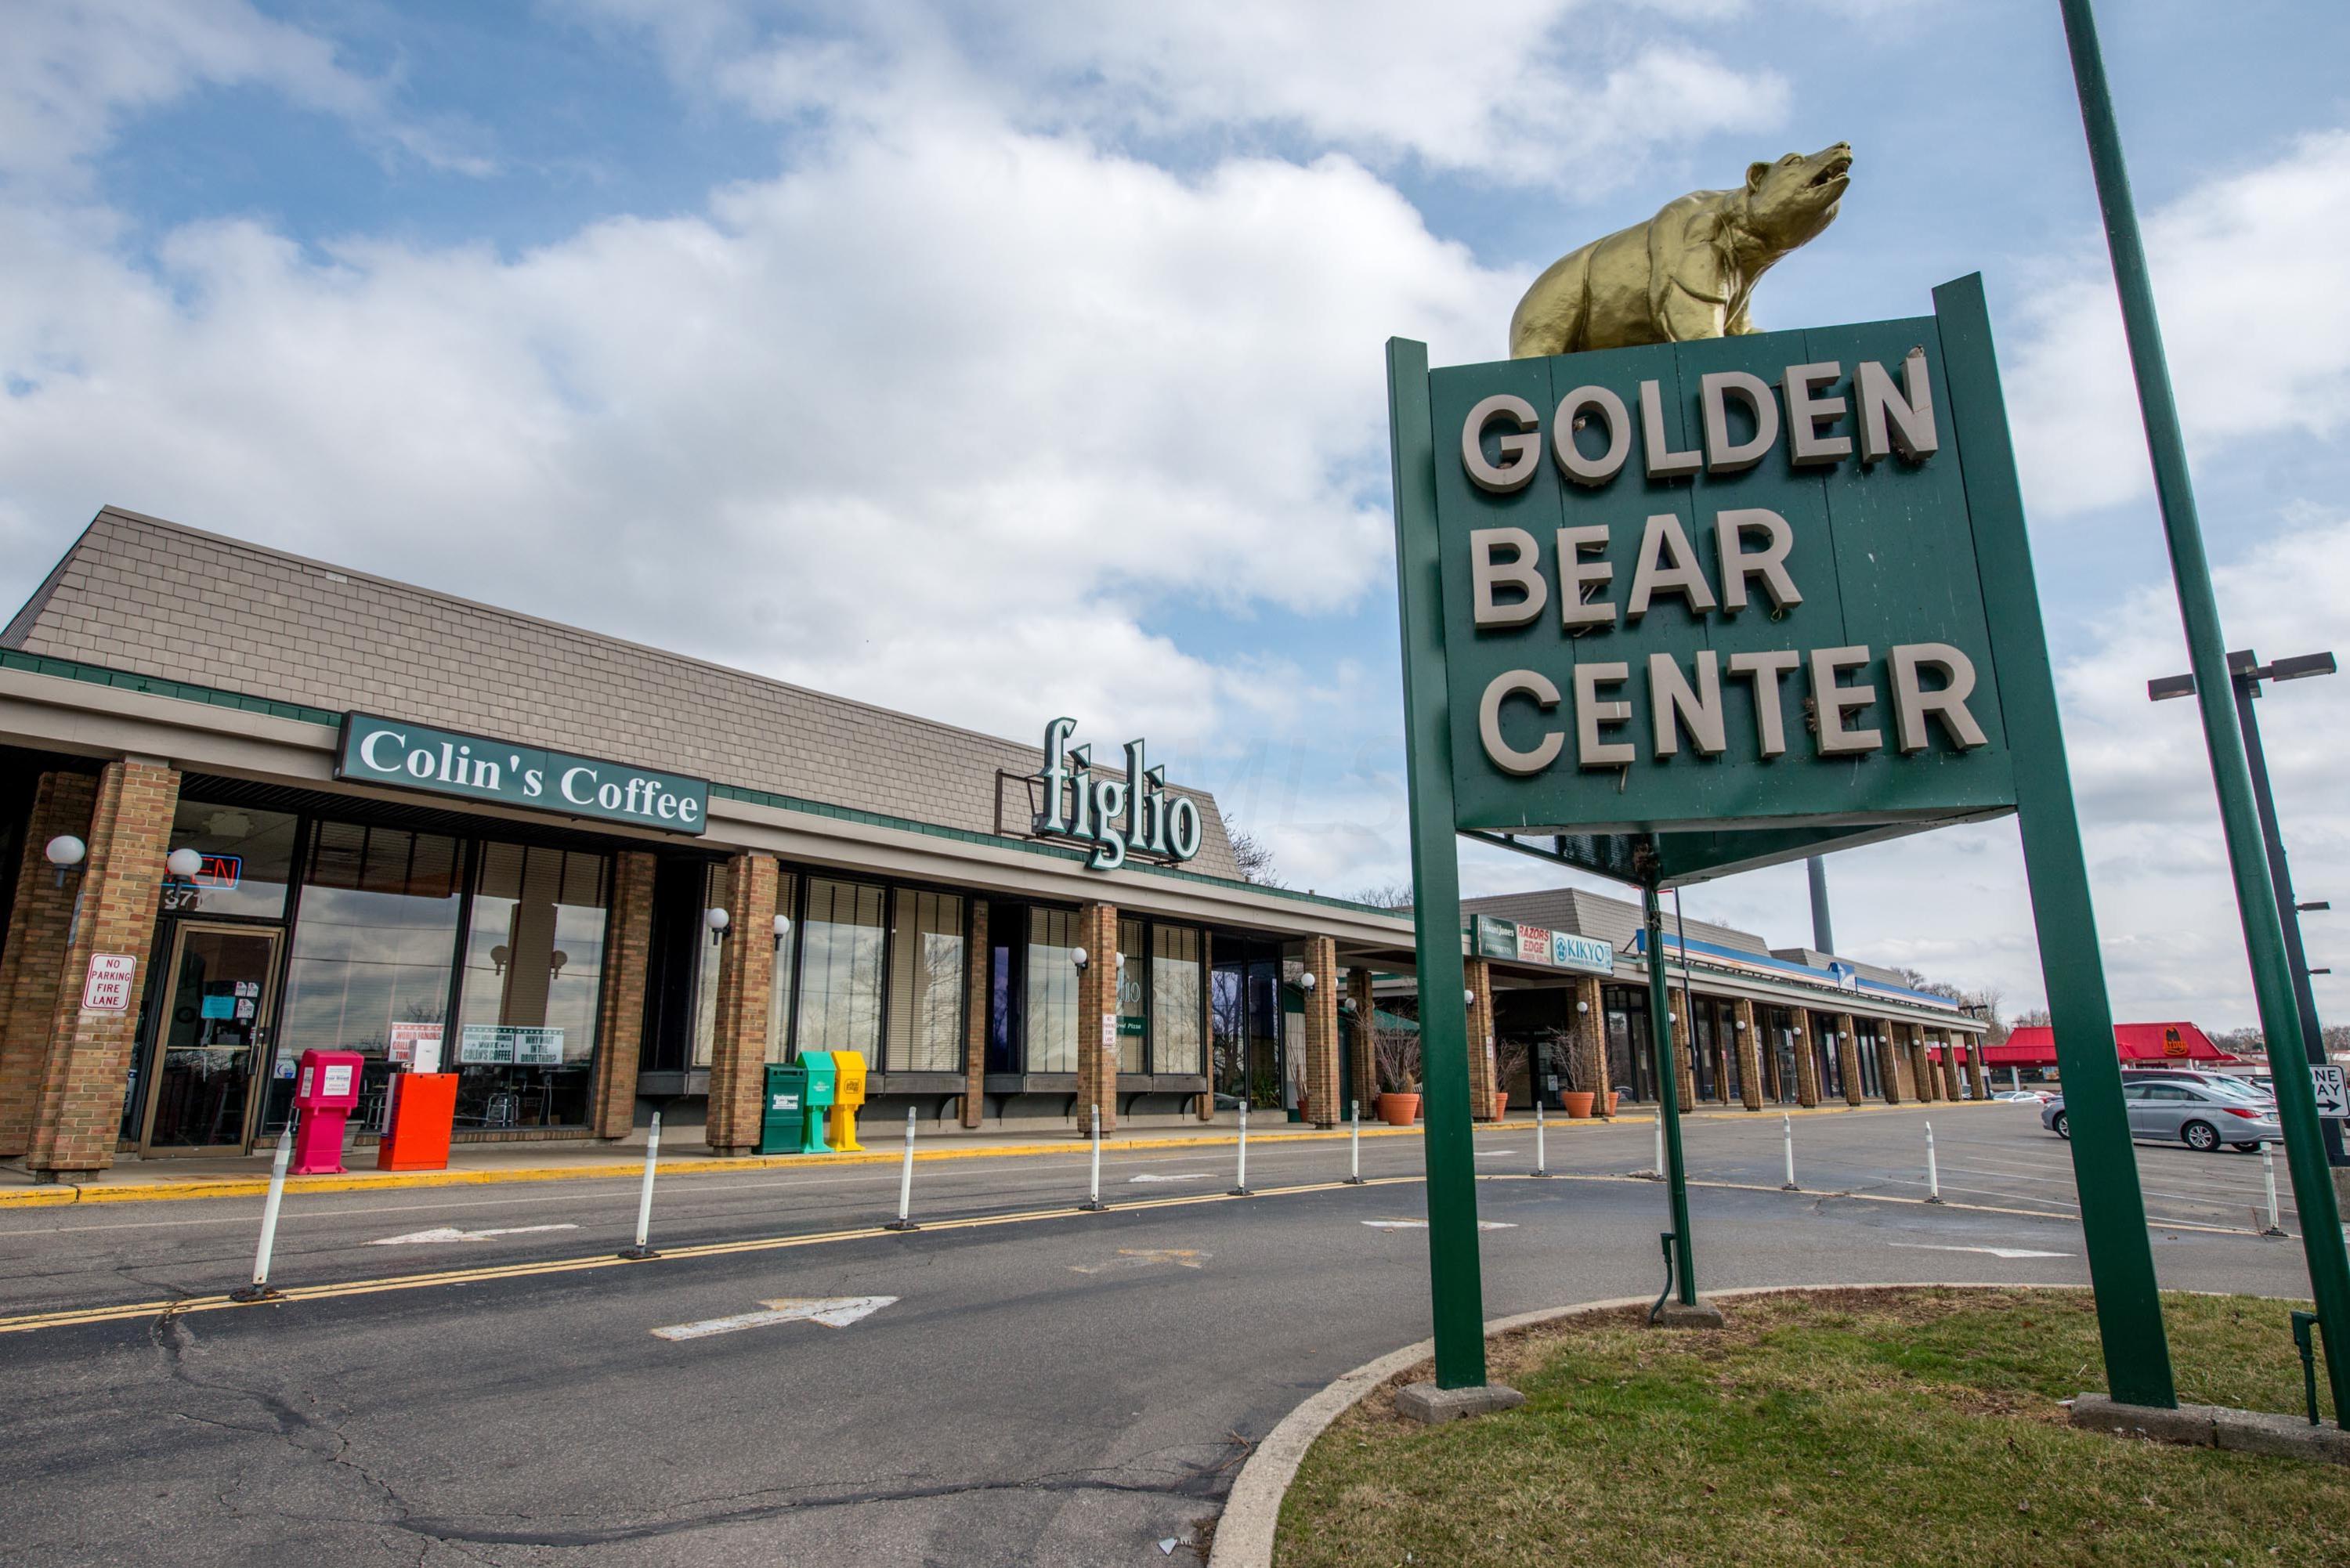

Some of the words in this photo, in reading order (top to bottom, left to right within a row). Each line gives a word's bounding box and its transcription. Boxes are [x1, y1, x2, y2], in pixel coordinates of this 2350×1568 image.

[1462, 356, 1938, 493] GOLDEN
[1470, 508, 1802, 629] BEAR
[1479, 642, 1988, 775] CENTER
[360, 730, 543, 797] Colin's
[561, 767, 698, 822] Coffee
[1039, 716, 1203, 871] figlio
[1518, 926, 1549, 941] RAZORS
[1523, 941, 1544, 953] EDGE
[1567, 939, 1604, 962] KIKYO
[107, 959, 120, 969] NO
[91, 970, 131, 982] PARKING
[96, 983, 121, 994] FIRE
[92, 995, 120, 1006] LANE
[396, 1031, 417, 1041] WORLD
[526, 1035, 539, 1044] WHY
[392, 1041, 409, 1050] GRILL
[531, 1045, 537, 1053] IN
[538, 1045, 548, 1053] THE
[464, 1050, 488, 1060] COLIN'S
[490, 1050, 512, 1061] COFFEE
[521, 1053, 537, 1062] DRIVE
[2313, 1070, 2338, 1082] NE
[2312, 1084, 2340, 1096] AY
